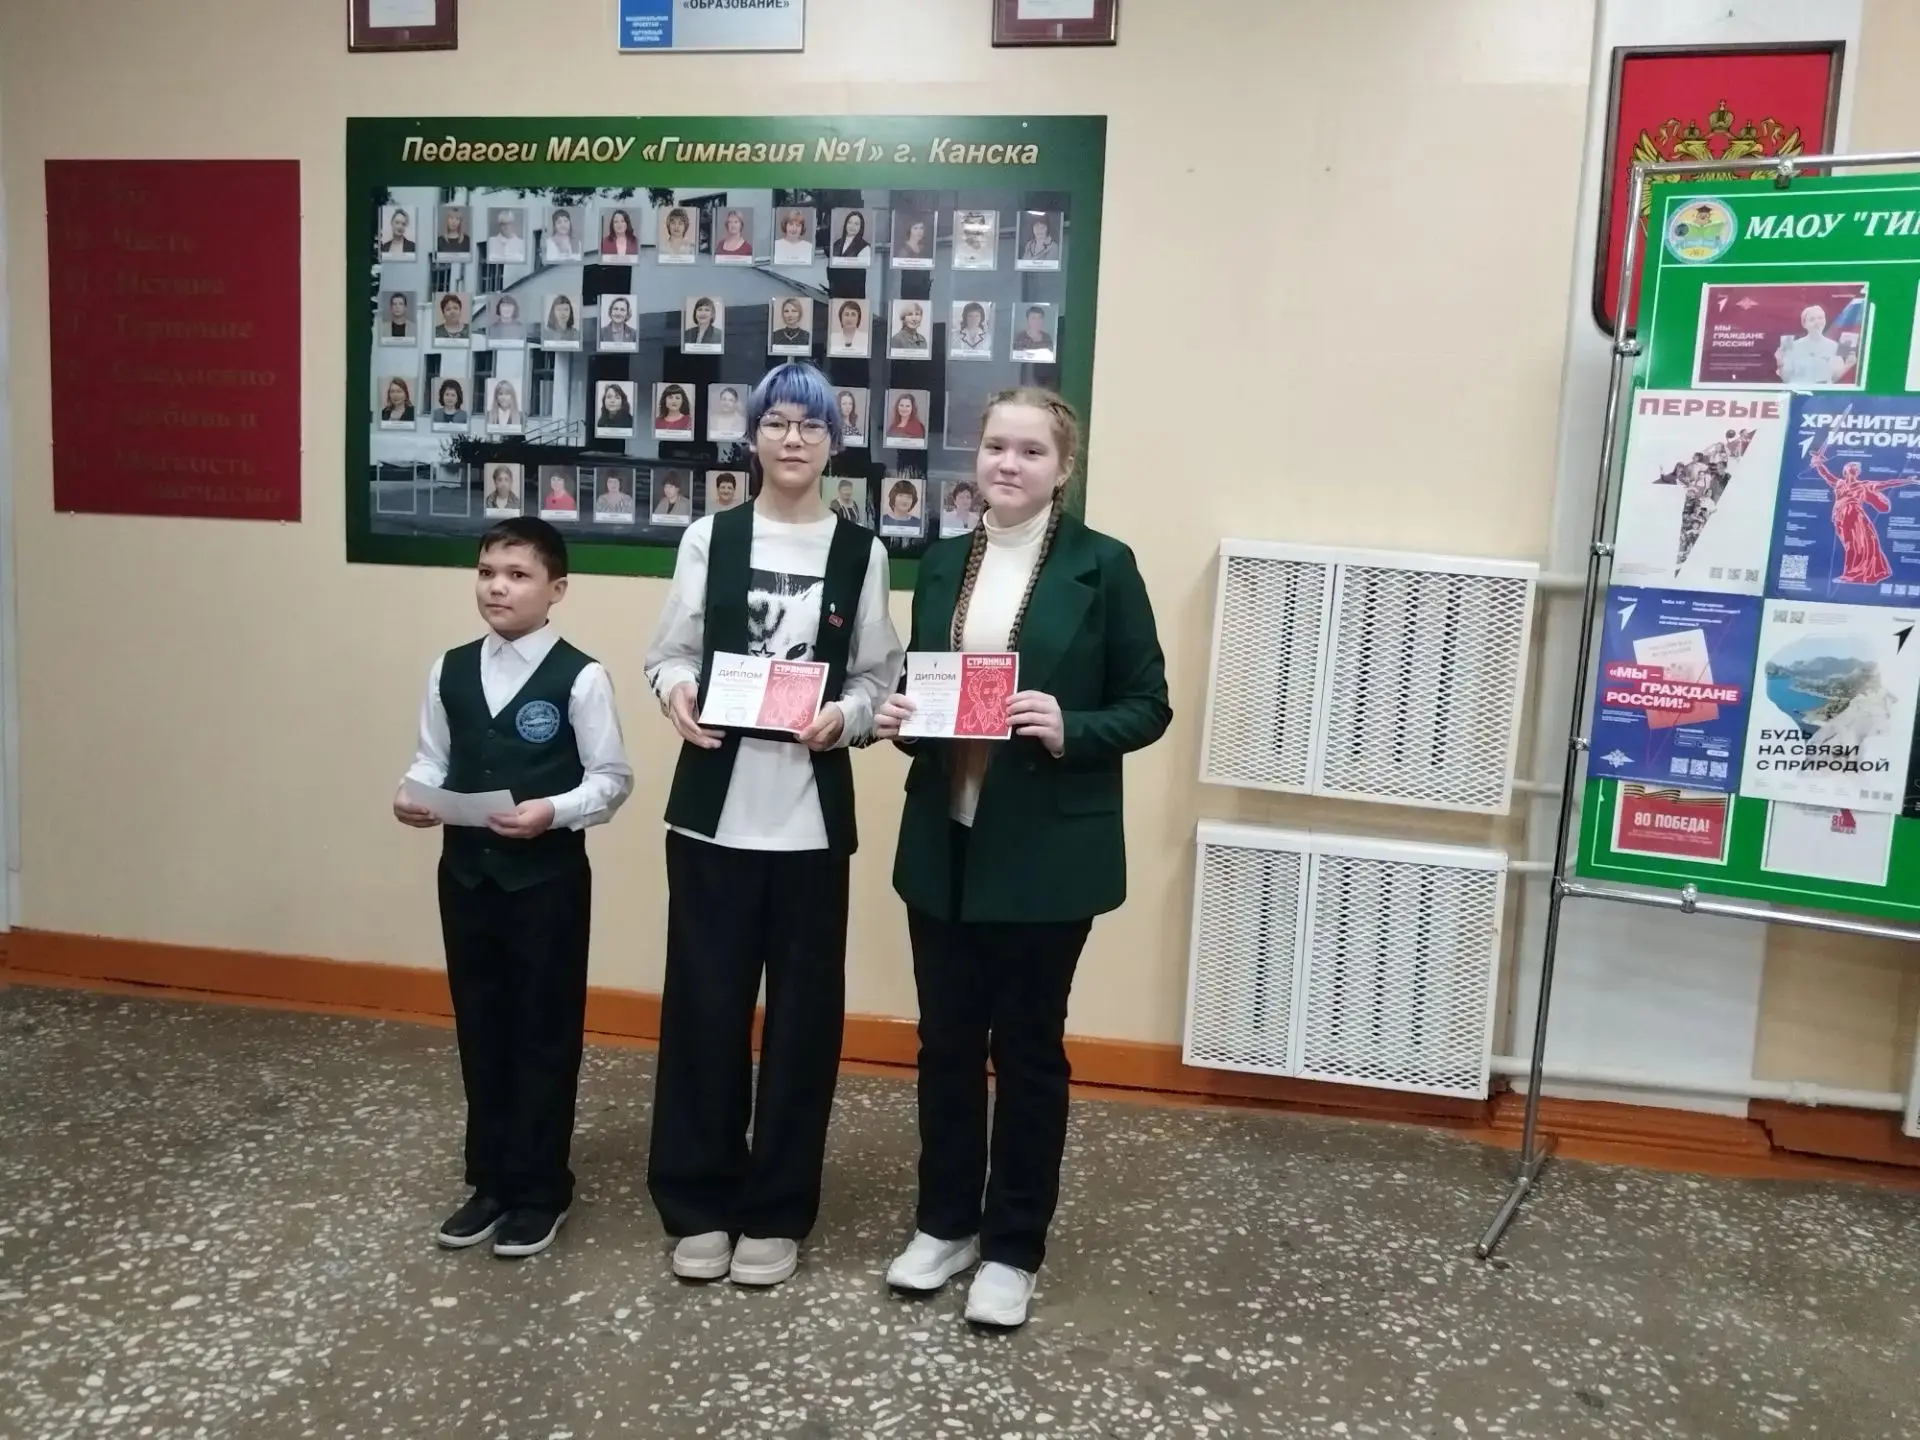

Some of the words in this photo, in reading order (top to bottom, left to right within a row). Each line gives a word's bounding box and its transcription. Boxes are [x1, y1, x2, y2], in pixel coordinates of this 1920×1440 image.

[683, 0, 790, 9] «ОБРАЗОВАНИЕ»
[401, 136, 538, 163] Педагоги
[546, 136, 637, 162] МАОУ
[641, 136, 805, 162] «Гимназия
[813, 137, 884, 163] №1»
[893, 143, 917, 163] г.
[928, 138, 1039, 164] Канска
[1744, 213, 1846, 239] МАОУ
[1639, 398, 1780, 419] ПЕРВЫЕ
[718, 669, 763, 679] ДИПЛОМ
[914, 673, 957, 681] ДИПЛОМ
[1609, 666, 1648, 680] «МЫ
[1640, 681, 1739, 701] ГРАЖДАНЕ
[1606, 691, 1691, 709] РОССИИ!»
[1760, 729, 1812, 742] БУДЬ
[1758, 745, 1786, 755] НА
[1790, 745, 1860, 756] СВЯЗИ
[1756, 760, 1770, 771] С
[1774, 758, 1890, 774] ПРИРОДОЙ
[1634, 811, 1652, 826] 80
[1654, 813, 1710, 833] ПОБЕДА!
